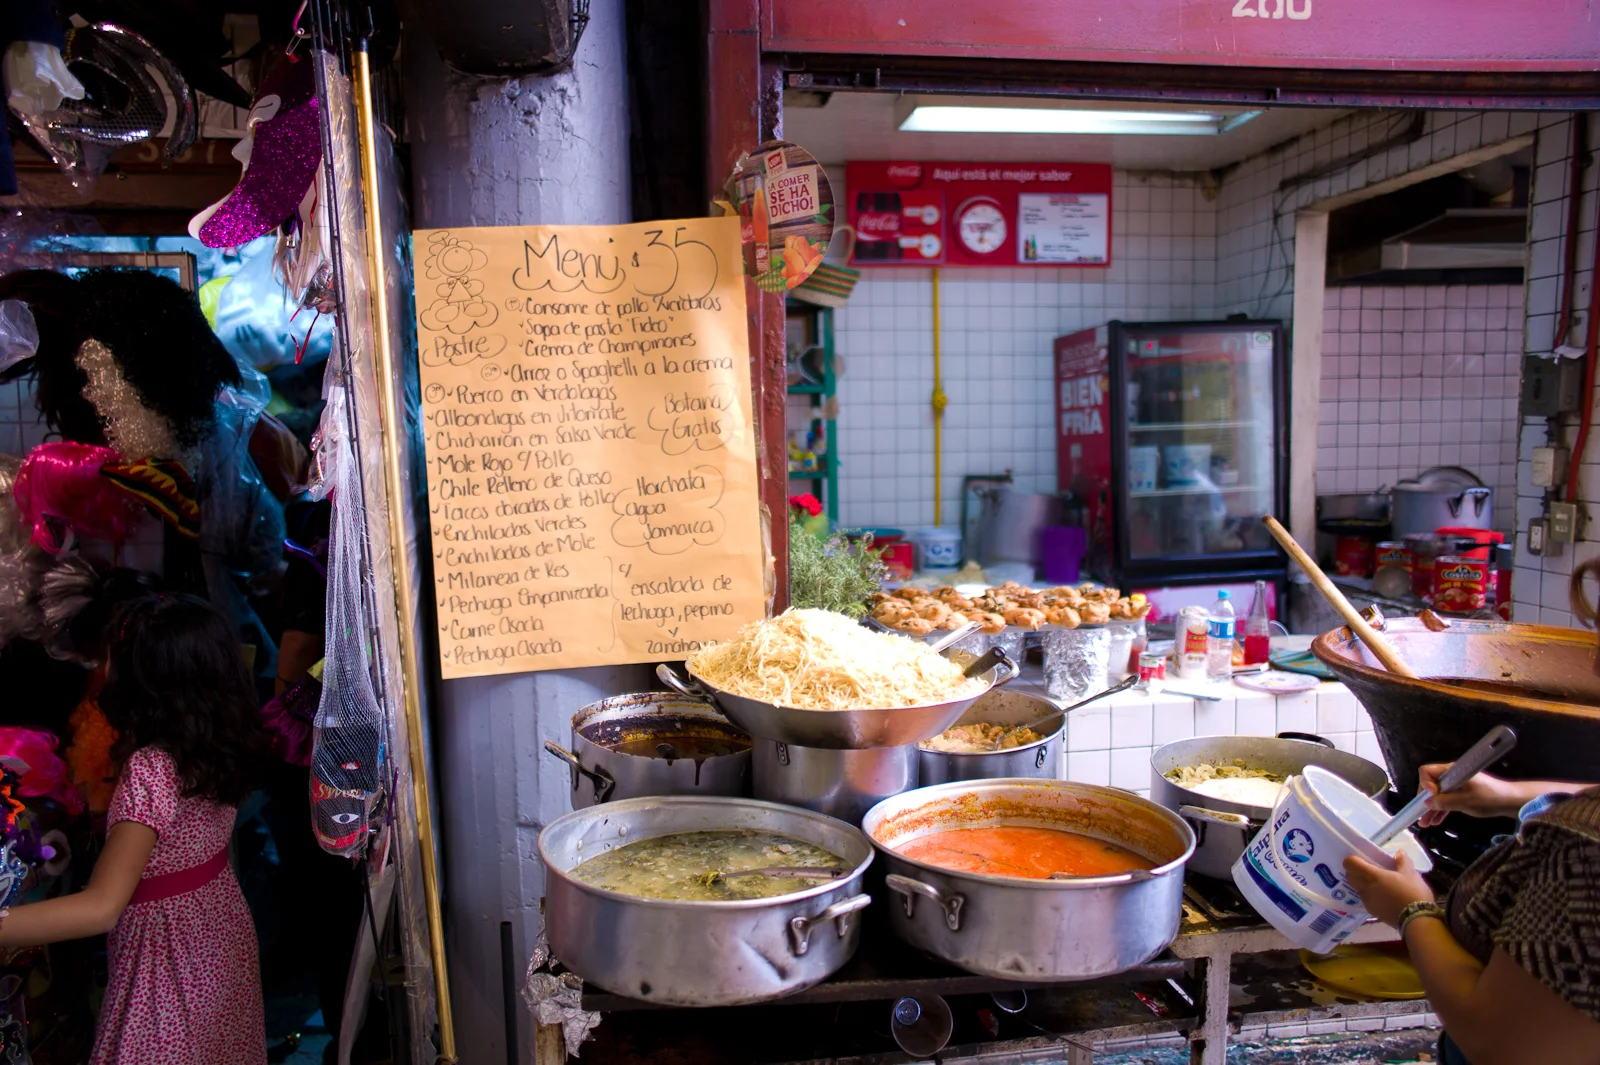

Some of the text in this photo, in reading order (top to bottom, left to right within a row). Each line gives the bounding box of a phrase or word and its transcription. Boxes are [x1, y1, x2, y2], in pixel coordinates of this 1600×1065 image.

[777, 173, 811, 189] COMER
[770, 183, 810, 204] SE HA
[770, 196, 814, 218] DICHO!
[596, 298, 612, 314] de
[617, 296, 649, 318] pollo
[526, 318, 560, 341] Sopa
[564, 320, 581, 335] de
[585, 318, 623, 340] pasta
[434, 335, 490, 358] Postre
[525, 339, 574, 357] Crema
[577, 340, 593, 355] de
[572, 356, 638, 385] Spaghetti
[662, 356, 679, 374] la
[683, 356, 733, 374] crema
[456, 384, 504, 404] Puerco
[511, 388, 529, 403] en
[534, 383, 617, 410] Verdolagas
[664, 391, 721, 414] Botana
[1061, 374, 1103, 409] BIEN
[531, 411, 551, 425] en
[672, 416, 722, 439] Gratis
[529, 433, 548, 446] en
[556, 424, 592, 444] Salsa
[594, 423, 637, 441] Verde
[437, 453, 477, 475] Mole
[482, 452, 513, 477] Rojo
[535, 449, 575, 470] Pollo
[439, 467, 612, 500] Chile Relleno de Queso
[636, 469, 706, 497] Horchata
[443, 488, 615, 521] Tacos dorados de Pollo
[535, 514, 587, 533] Verdes
[642, 520, 714, 541] Jamaica
[535, 540, 554, 557] de
[556, 532, 596, 553] Mole
[524, 565, 540, 581] de
[545, 560, 570, 579] Res
[631, 574, 733, 597] ensalada de
[449, 594, 512, 616] Pechuga
[450, 618, 496, 641] Carne
[453, 644, 515, 667] Pechuga
